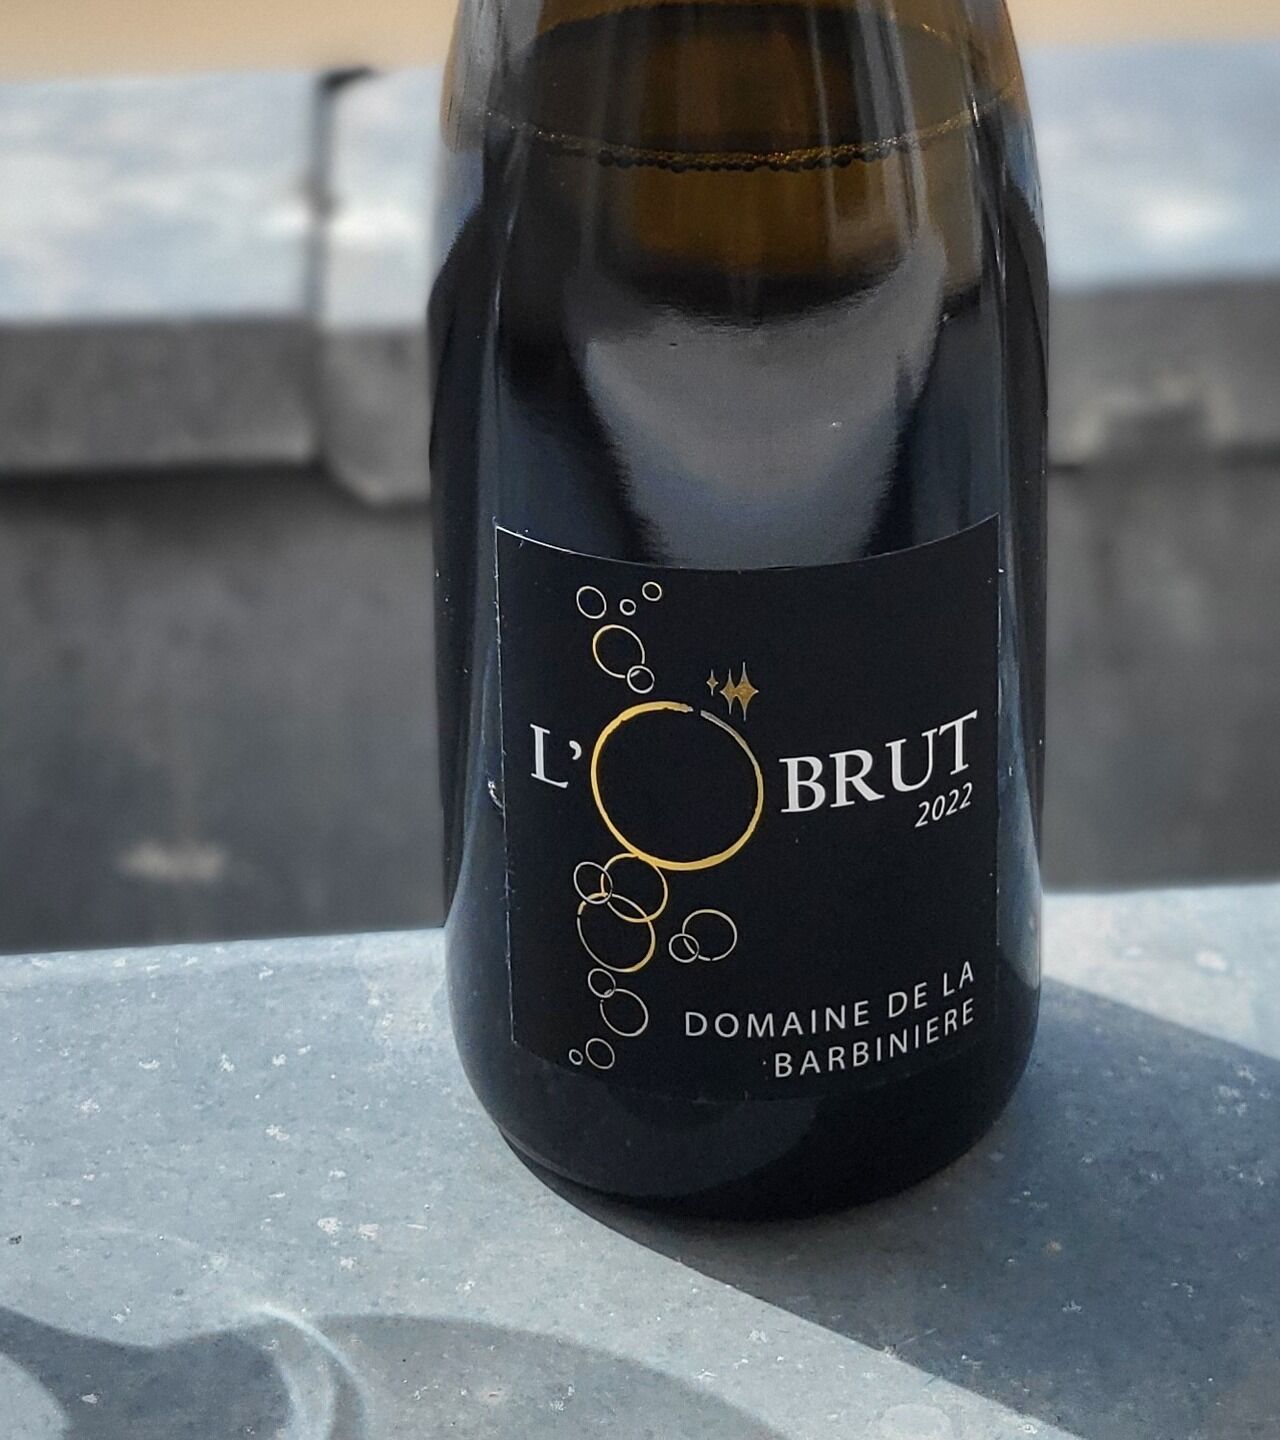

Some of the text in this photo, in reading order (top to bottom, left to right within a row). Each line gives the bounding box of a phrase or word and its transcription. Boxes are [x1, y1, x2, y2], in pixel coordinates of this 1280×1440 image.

[779, 710, 977, 813] BRUT
[915, 782, 973, 828] 2022
[685, 961, 974, 1038] DOMAINE DE LA
